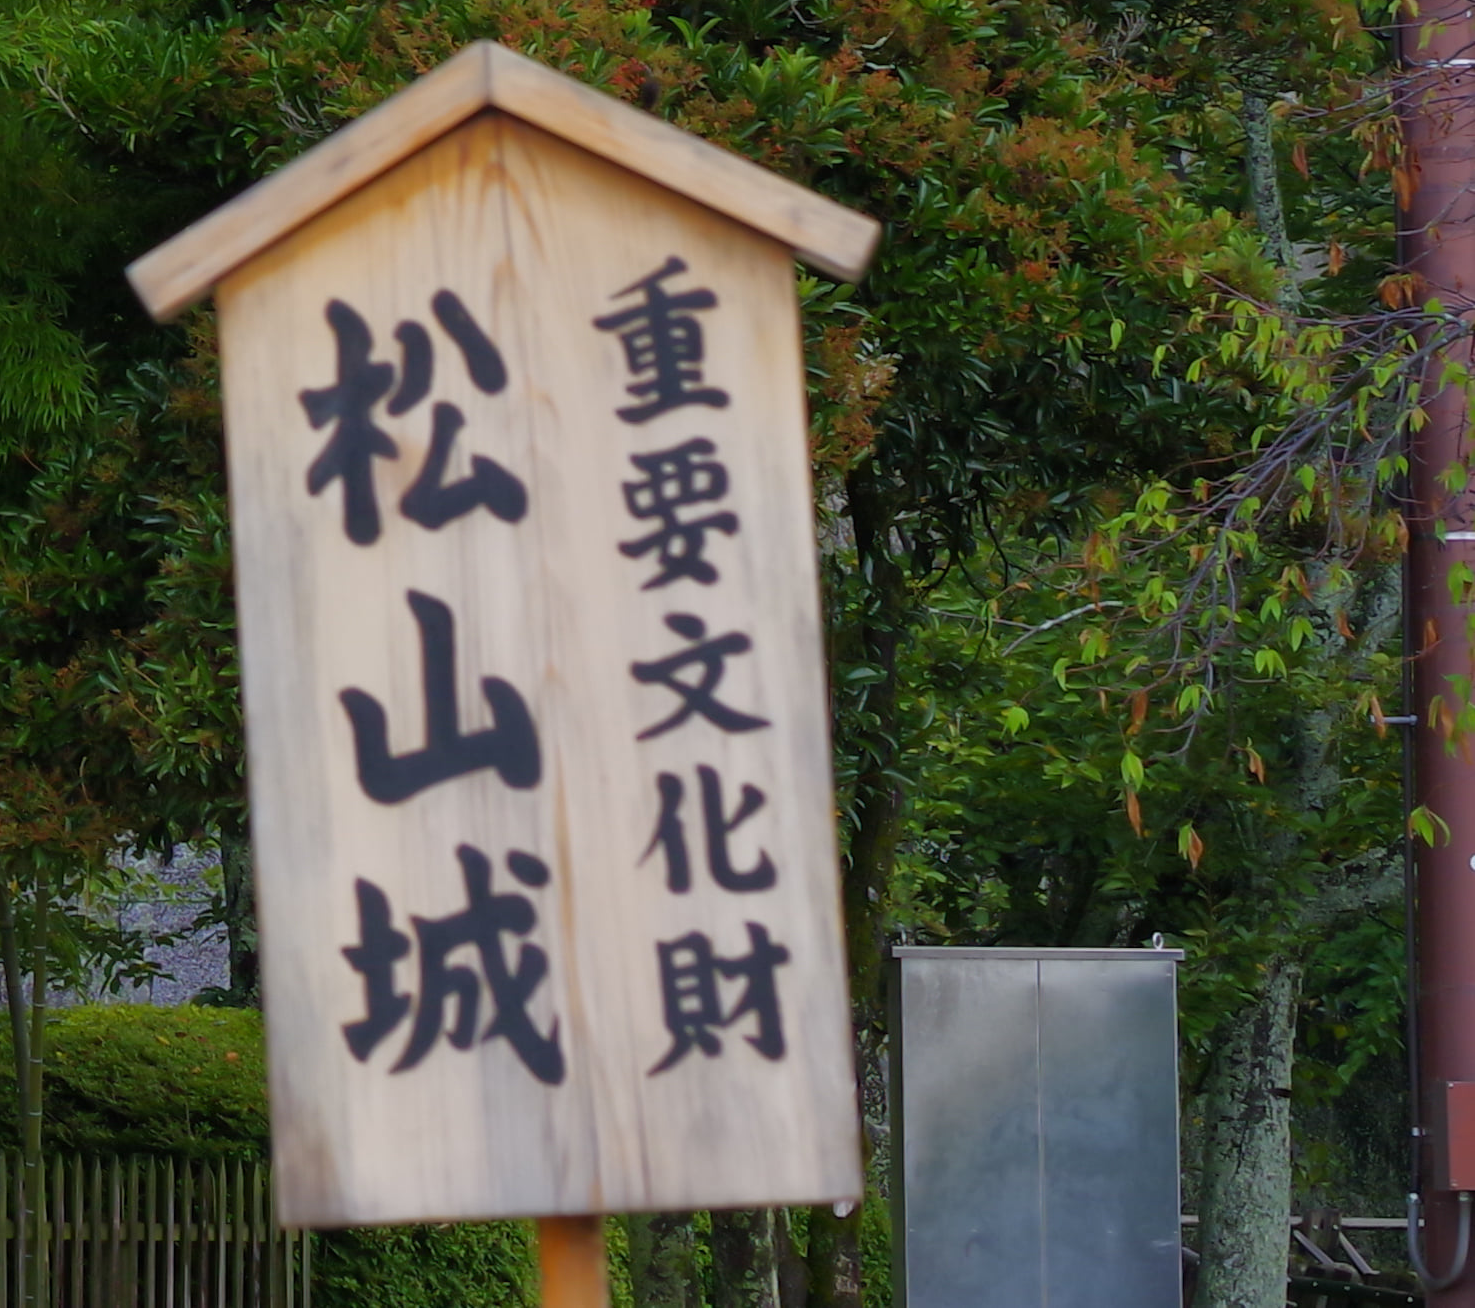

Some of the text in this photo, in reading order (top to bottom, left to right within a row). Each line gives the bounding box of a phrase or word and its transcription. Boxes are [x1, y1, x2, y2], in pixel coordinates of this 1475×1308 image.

[299, 289, 566, 1087] 松山城
[593, 255, 791, 1077] 重要文化財
